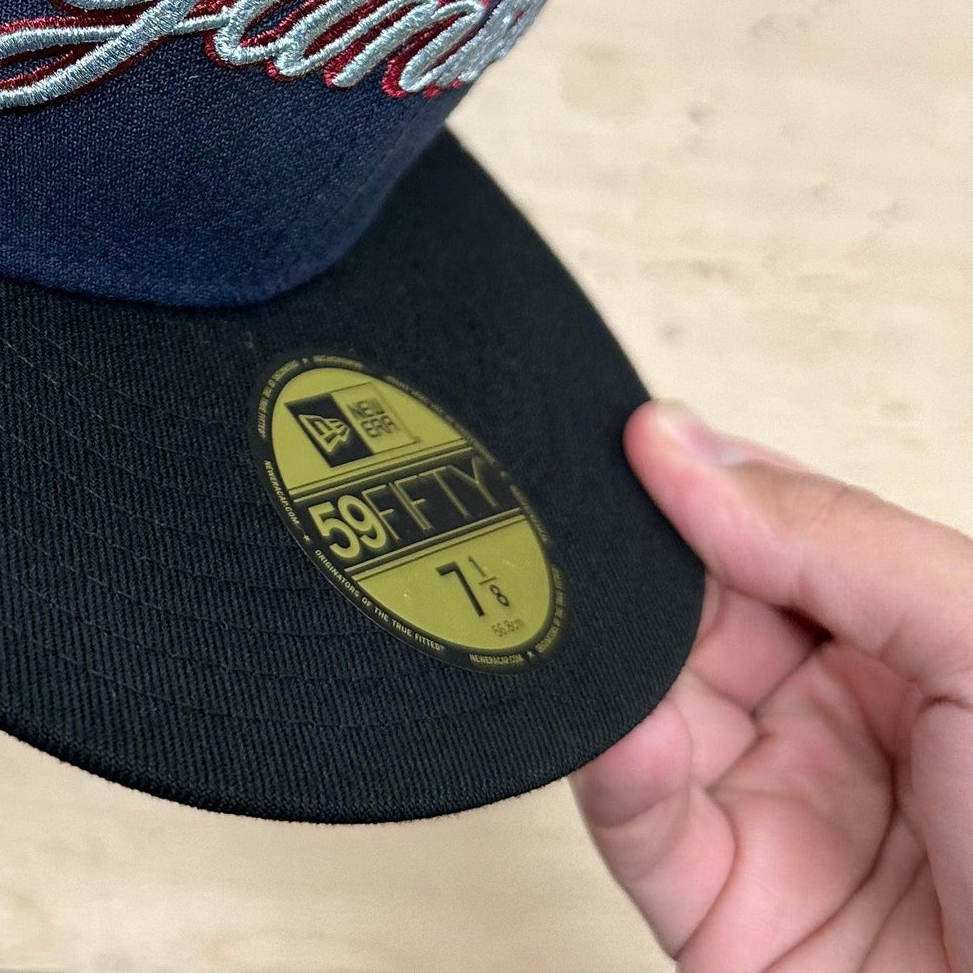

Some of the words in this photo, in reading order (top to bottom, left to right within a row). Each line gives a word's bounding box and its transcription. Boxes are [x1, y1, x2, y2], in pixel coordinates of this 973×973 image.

[308, 456, 499, 558] 59FIFTY
[314, 549, 360, 597] ORIGINATORS
[361, 596, 372, 607] OF
[374, 607, 389, 622] THE
[391, 619, 412, 637] TRUE
[436, 561, 485, 617] 7
